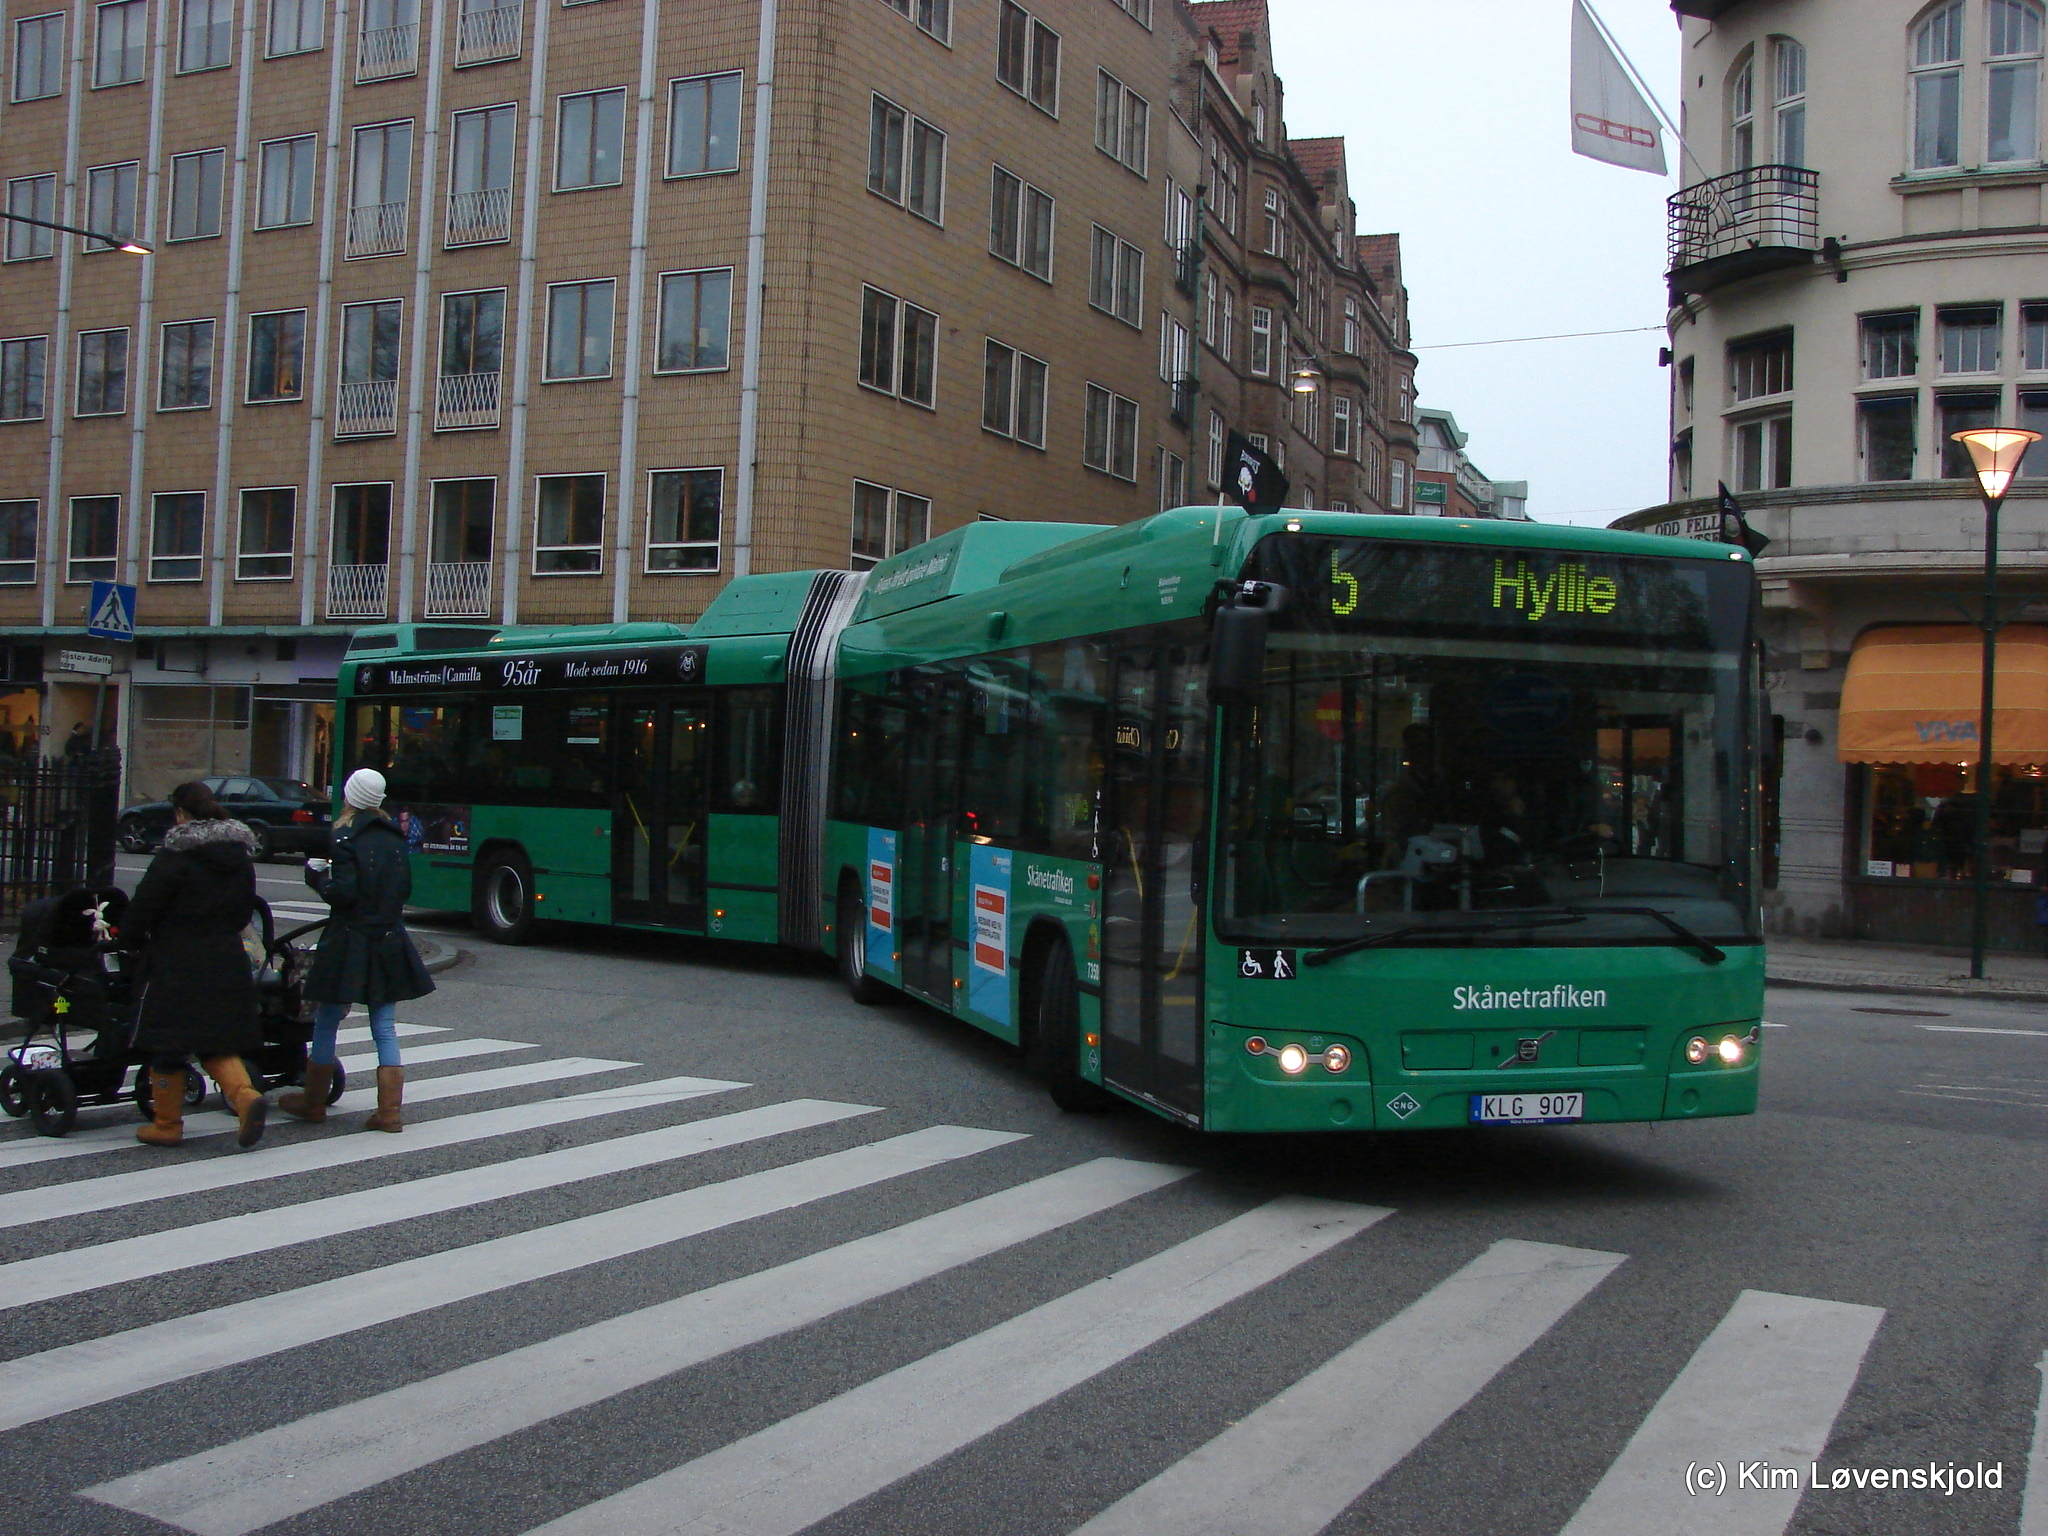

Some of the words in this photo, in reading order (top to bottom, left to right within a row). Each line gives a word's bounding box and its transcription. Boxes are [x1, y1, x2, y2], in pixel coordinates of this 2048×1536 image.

[1656, 522, 1680, 536] ODD
[1687, 516, 1720, 533] FELL
[1331, 549, 1358, 614] 5
[1493, 559, 1617, 621] Hyllie
[564, 662, 590, 678] Mode
[591, 660, 619, 677] sedan
[622, 658, 649, 676] 1916
[1914, 720, 1980, 742] VIVA
[1026, 865, 1074, 894] Skånetrafiken
[1452, 984, 1607, 1010] Skånetrafiken
[1393, 1101, 1414, 1110] CNG
[1484, 1097, 1524, 1117] KLG
[1540, 1095, 1578, 1116] 907
